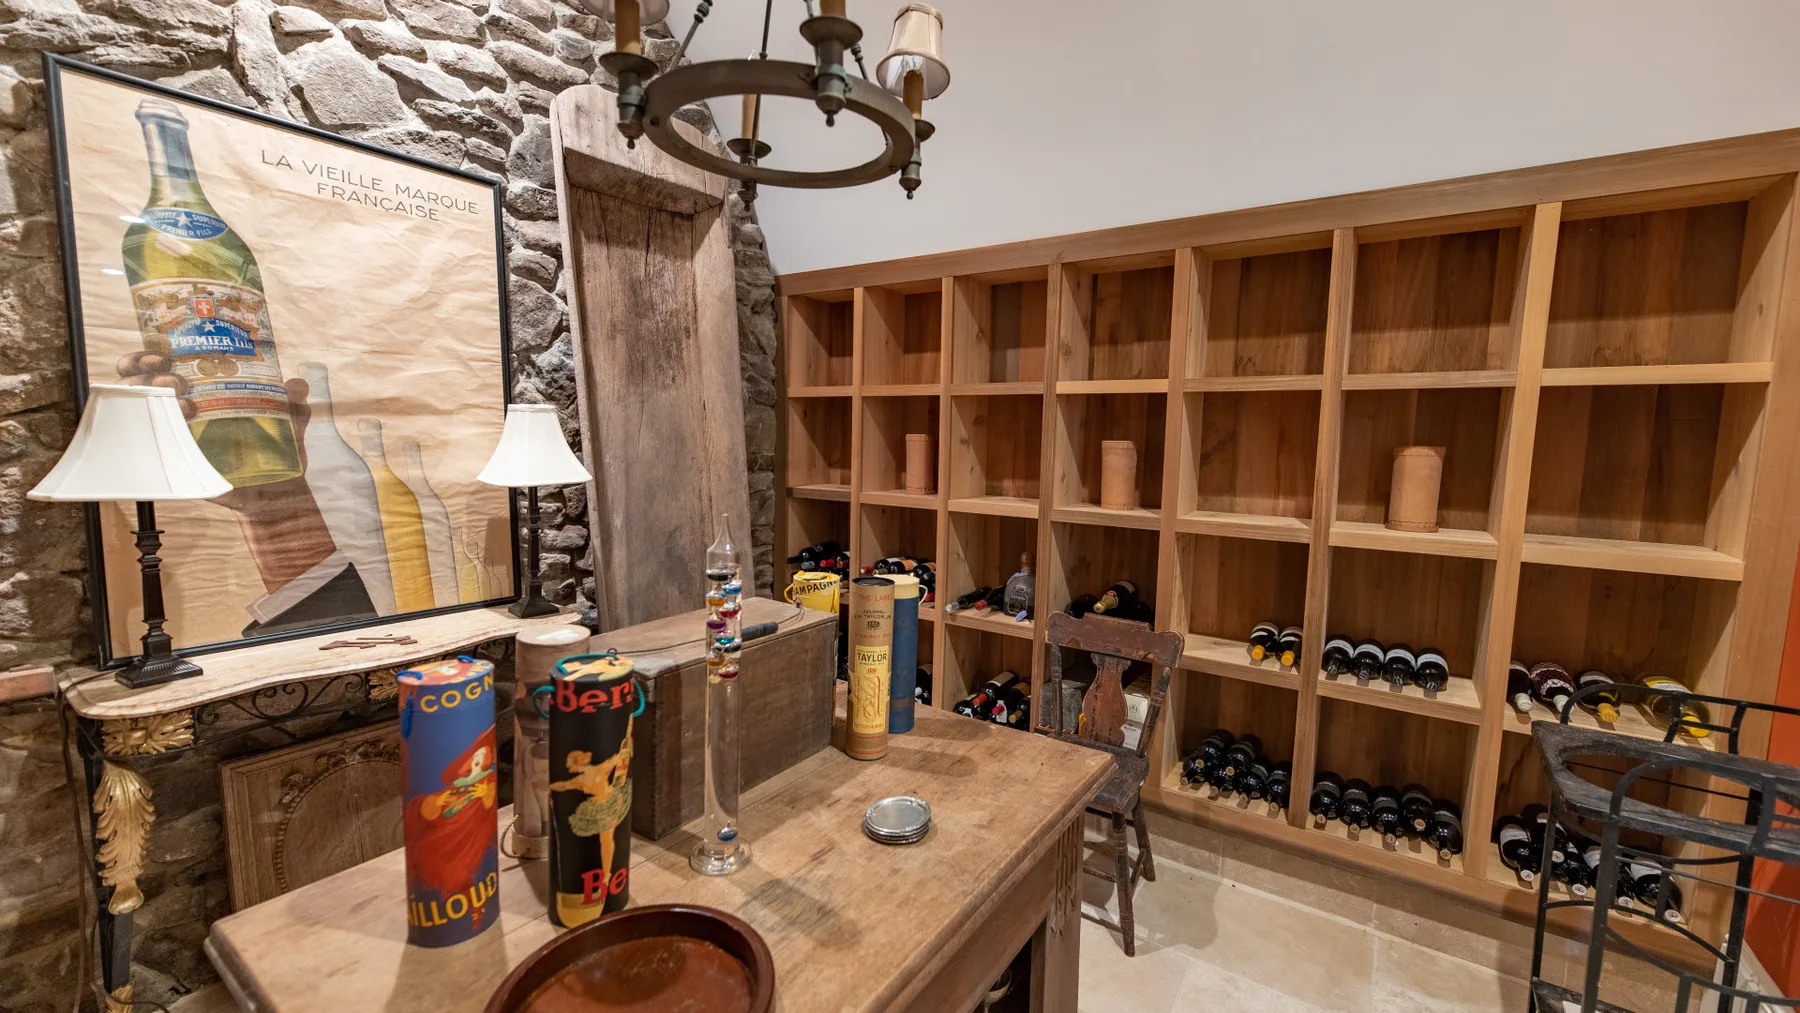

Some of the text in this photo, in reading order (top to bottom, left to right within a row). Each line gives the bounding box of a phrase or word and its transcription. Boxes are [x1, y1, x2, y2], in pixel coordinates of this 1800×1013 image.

[262, 150, 479, 215] LA VIEILLE MARQUE
[317, 182, 440, 222] FRANÇAISE
[170, 335, 234, 349] PREMIER
[857, 653, 888, 662] TAYLOR
